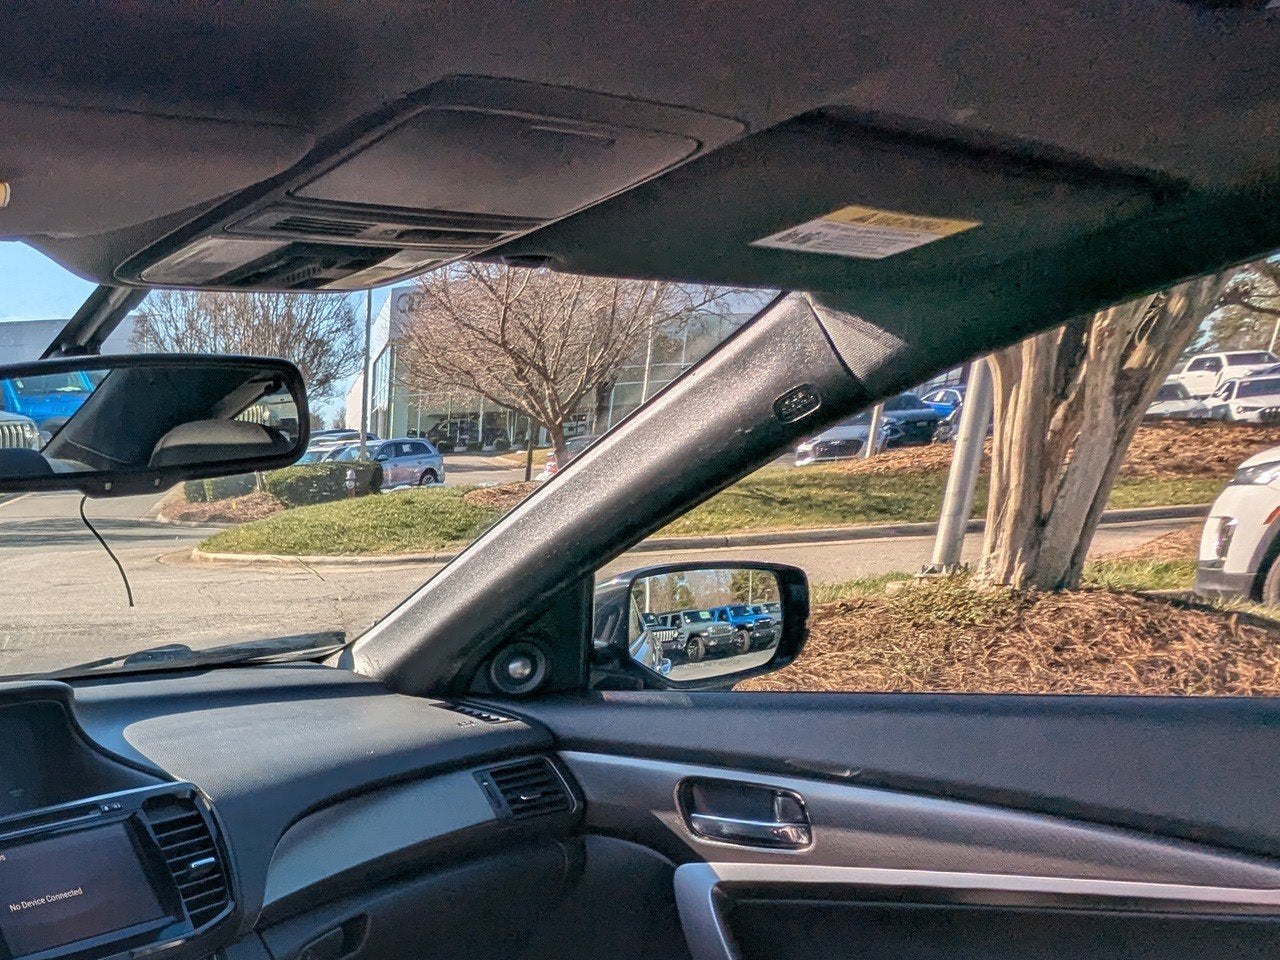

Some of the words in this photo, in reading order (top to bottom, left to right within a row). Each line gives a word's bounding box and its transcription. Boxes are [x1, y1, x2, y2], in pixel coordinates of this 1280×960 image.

[9, 903, 21, 912] No
[21, 897, 46, 909] Device
[46, 887, 83, 903] Connected
